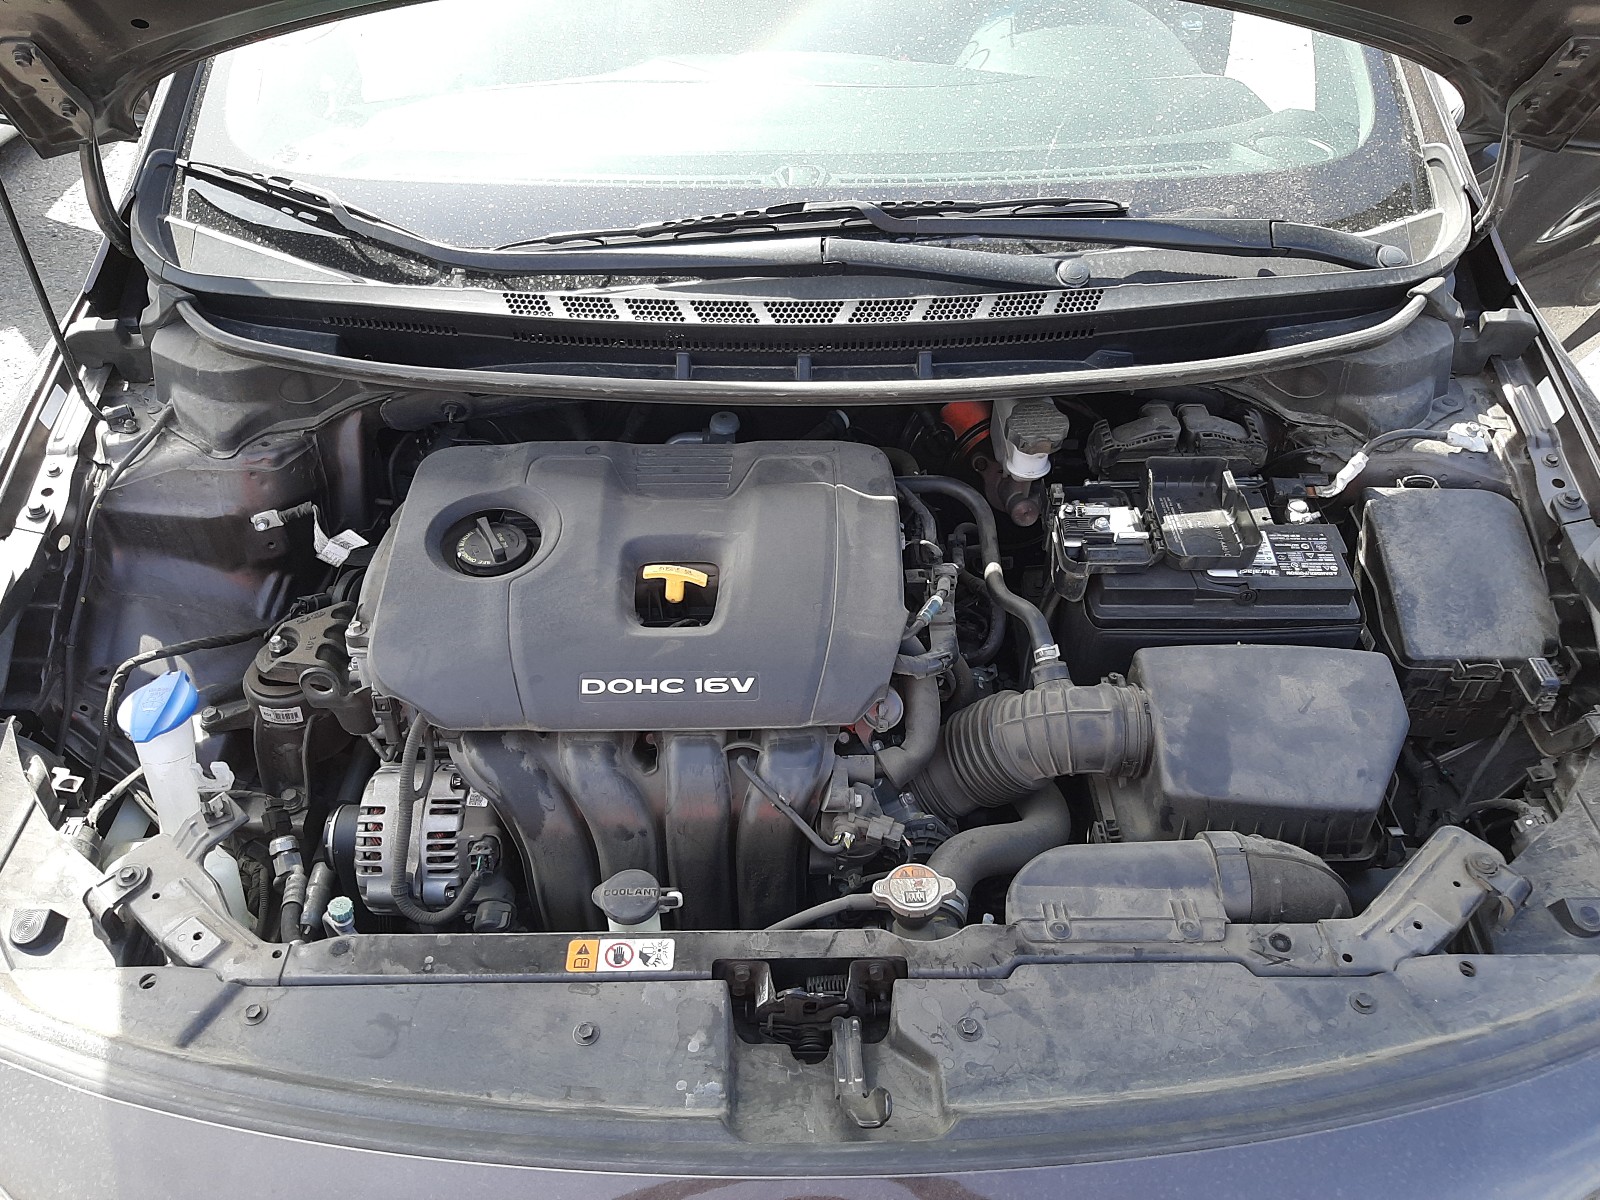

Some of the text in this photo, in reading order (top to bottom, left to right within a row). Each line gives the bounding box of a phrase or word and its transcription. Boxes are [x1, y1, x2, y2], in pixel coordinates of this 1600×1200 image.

[581, 677, 755, 694] DOHC 16V
[603, 888, 659, 896] COOLANT
